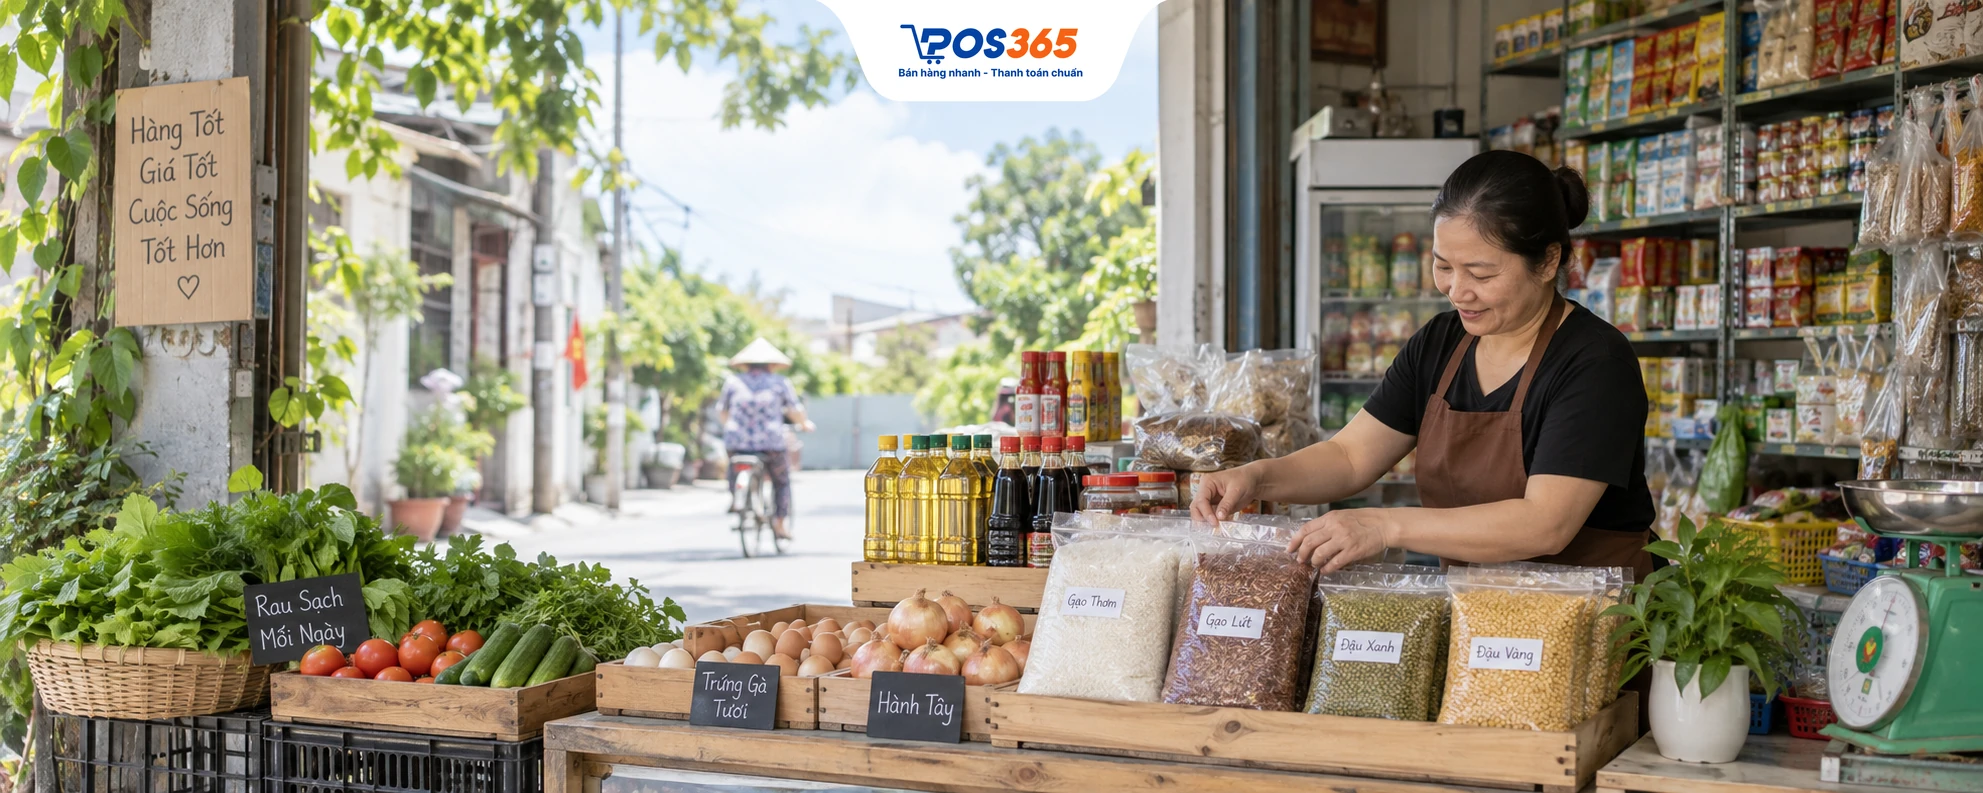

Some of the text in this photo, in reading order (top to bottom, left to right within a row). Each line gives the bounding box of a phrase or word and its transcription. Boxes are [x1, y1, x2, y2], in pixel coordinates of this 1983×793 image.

[131, 108, 225, 150] Hàng Tốt
[140, 150, 218, 184] Giá Tốt
[129, 191, 233, 227] Cuộc Sống
[141, 233, 225, 264] Tốt Hơn
[255, 585, 344, 617] Rau Sạch
[1067, 593, 1117, 609] Gạo Thơm
[299, 621, 345, 649] Ngày
[1205, 612, 1228, 630] Gạo
[1340, 637, 1395, 655] Đậu Xanh
[1505, 646, 1534, 667] Vàng
[747, 673, 767, 697] Gà
[713, 698, 748, 719] Tươi
[877, 690, 954, 726] Hành Tây
